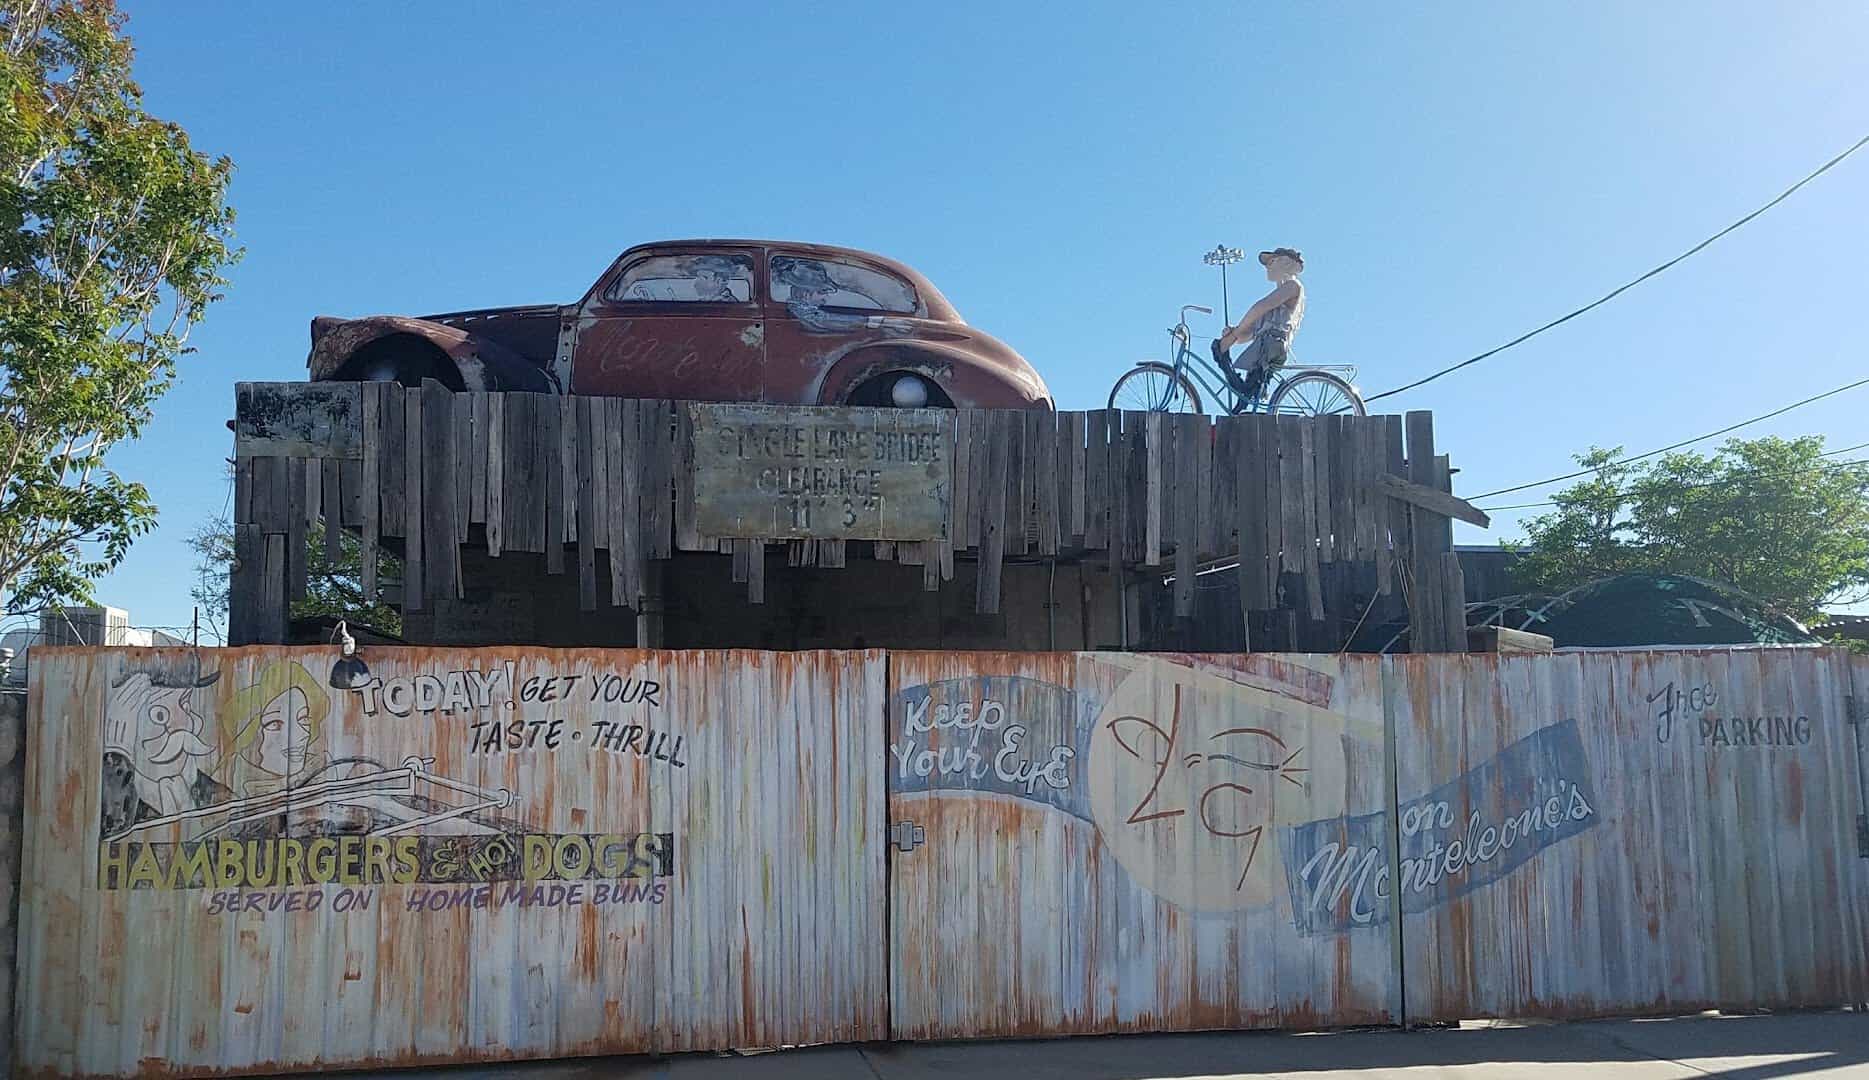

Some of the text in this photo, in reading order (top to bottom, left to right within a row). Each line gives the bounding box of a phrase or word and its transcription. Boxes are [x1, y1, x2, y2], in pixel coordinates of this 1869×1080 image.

[813, 429, 869, 460] LANE
[873, 432, 941, 464] BRIDGE
[756, 467, 881, 499] CLEARANCE
[351, 660, 661, 717] TODAY! GET YOUR
[1646, 681, 1720, 744] Free
[1698, 715, 1812, 747] PARKING
[470, 719, 686, 768] TASTE THRILL
[890, 739, 990, 779] Your
[1401, 800, 1454, 837] on
[100, 835, 421, 890] HAMBURGERS
[468, 832, 516, 881] HOT
[523, 833, 666, 880] DOGS
[207, 883, 667, 915] SERVED ON HOME MADE BUNS
